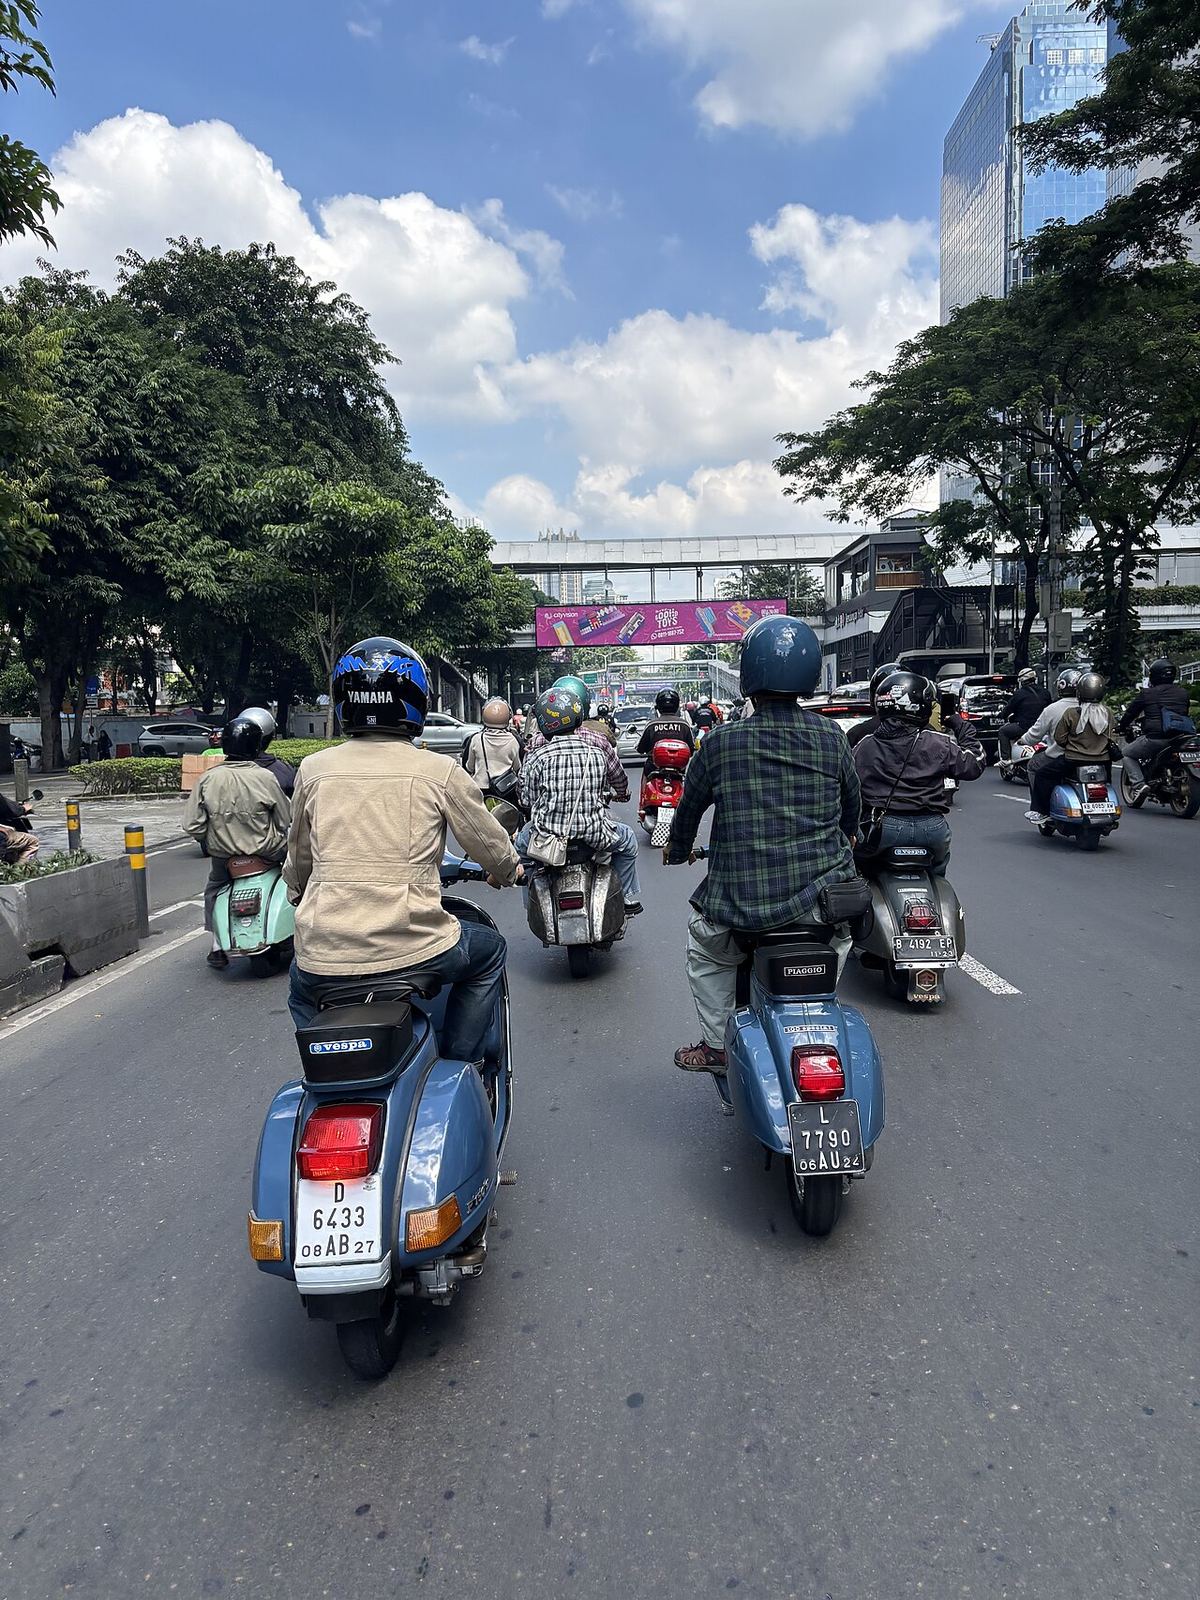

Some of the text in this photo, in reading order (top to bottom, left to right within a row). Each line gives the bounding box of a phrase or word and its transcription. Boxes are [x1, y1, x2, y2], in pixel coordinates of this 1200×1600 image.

[553, 612, 579, 620] cityvision
[657, 617, 678, 628] TOYS
[347, 690, 394, 704] YAMAHA
[654, 723, 681, 732] DUCATI
[896, 938, 953, 950] B 4192 EP
[787, 966, 823, 975] PIAGGIO
[912, 993, 941, 1001] vespa
[322, 1040, 367, 1051] vespa
[820, 1106, 830, 1124] L
[801, 1129, 850, 1150] 7790
[799, 1159, 817, 1171] 06
[819, 1150, 840, 1170] AU
[334, 1182, 345, 1204] D
[313, 1205, 365, 1230] 6433
[301, 1233, 375, 1258] 08 AB 27
